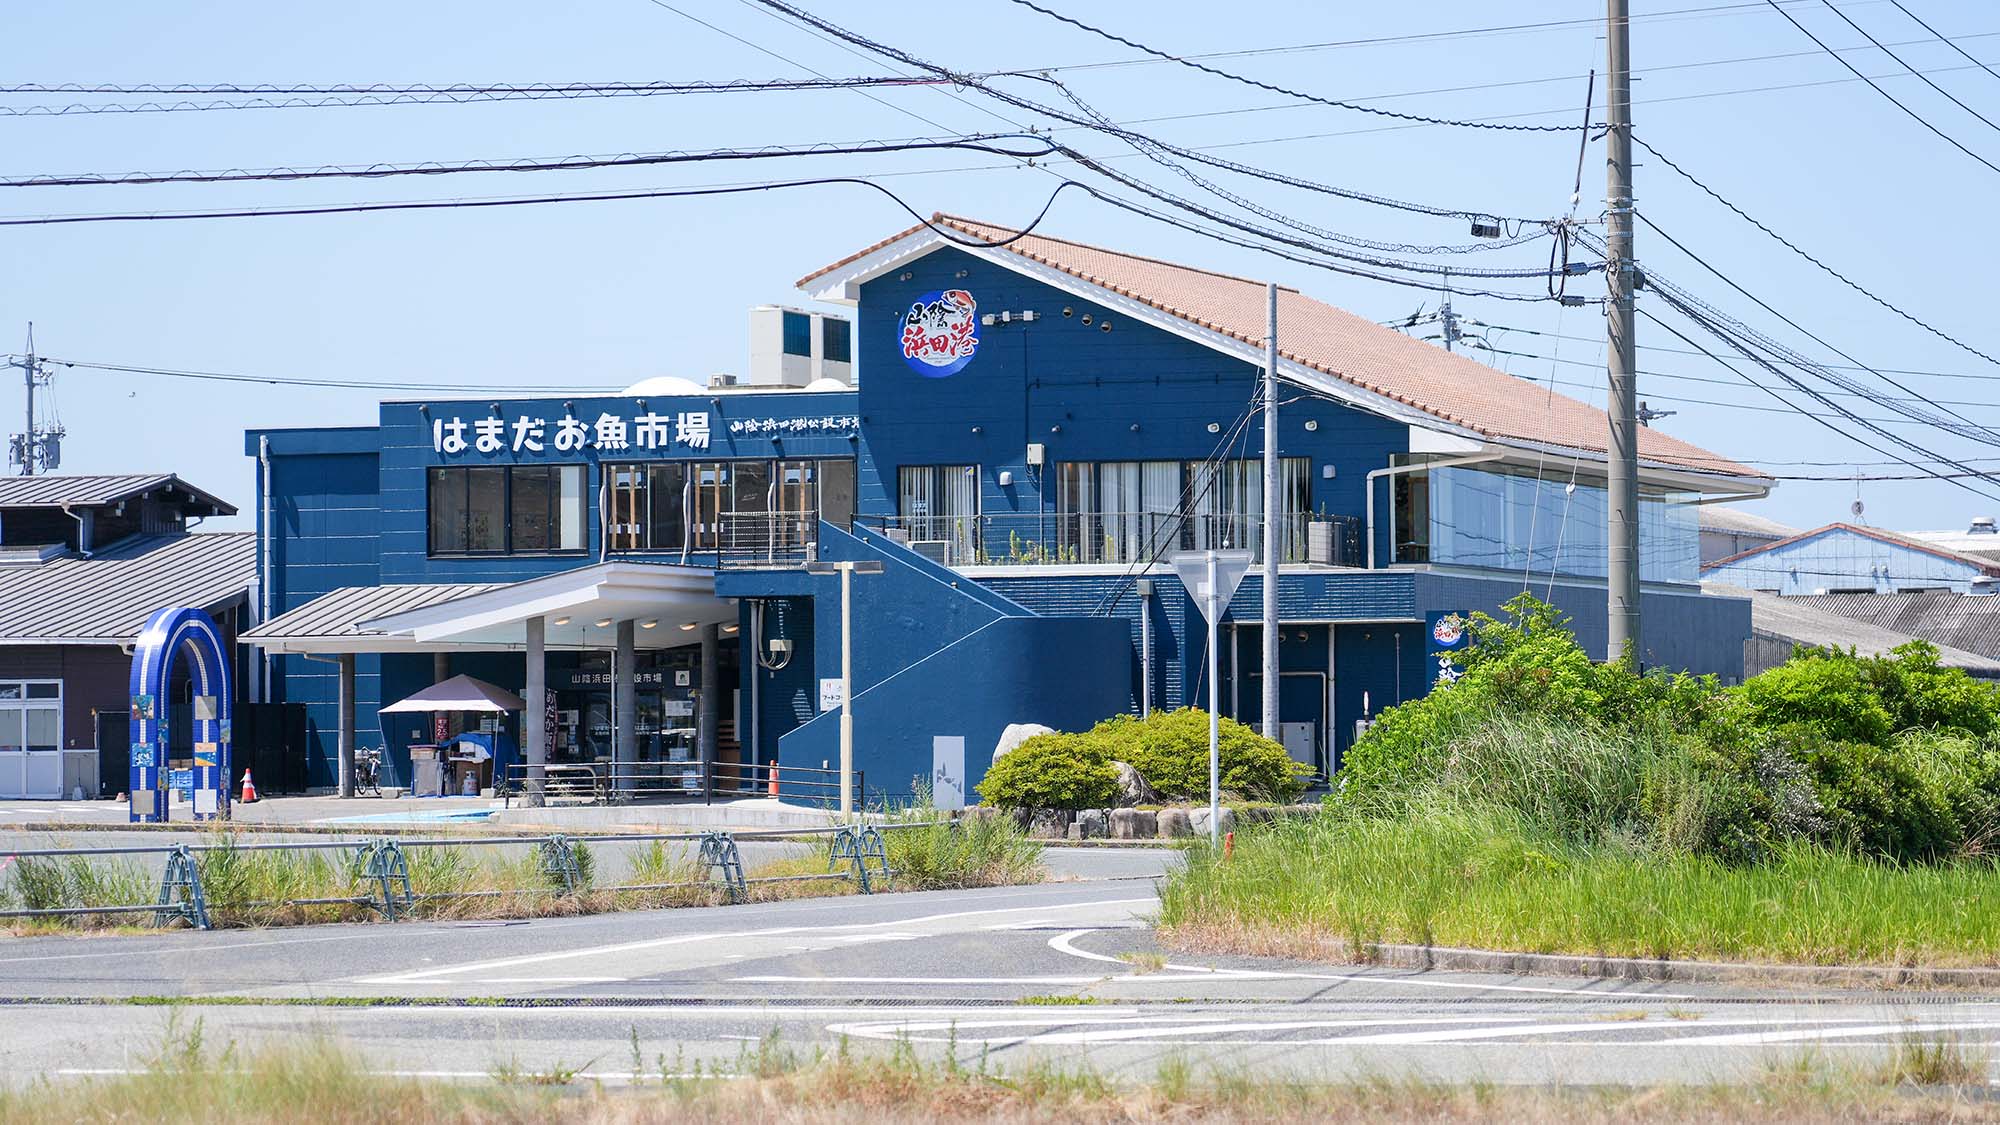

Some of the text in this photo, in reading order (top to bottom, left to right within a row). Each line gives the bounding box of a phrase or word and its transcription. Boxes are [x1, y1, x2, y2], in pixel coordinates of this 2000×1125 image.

[902, 315, 978, 357] 浜田港
[433, 411, 710, 453] はまだお魚市場
[571, 673, 662, 684] 山陰浜田設市場
